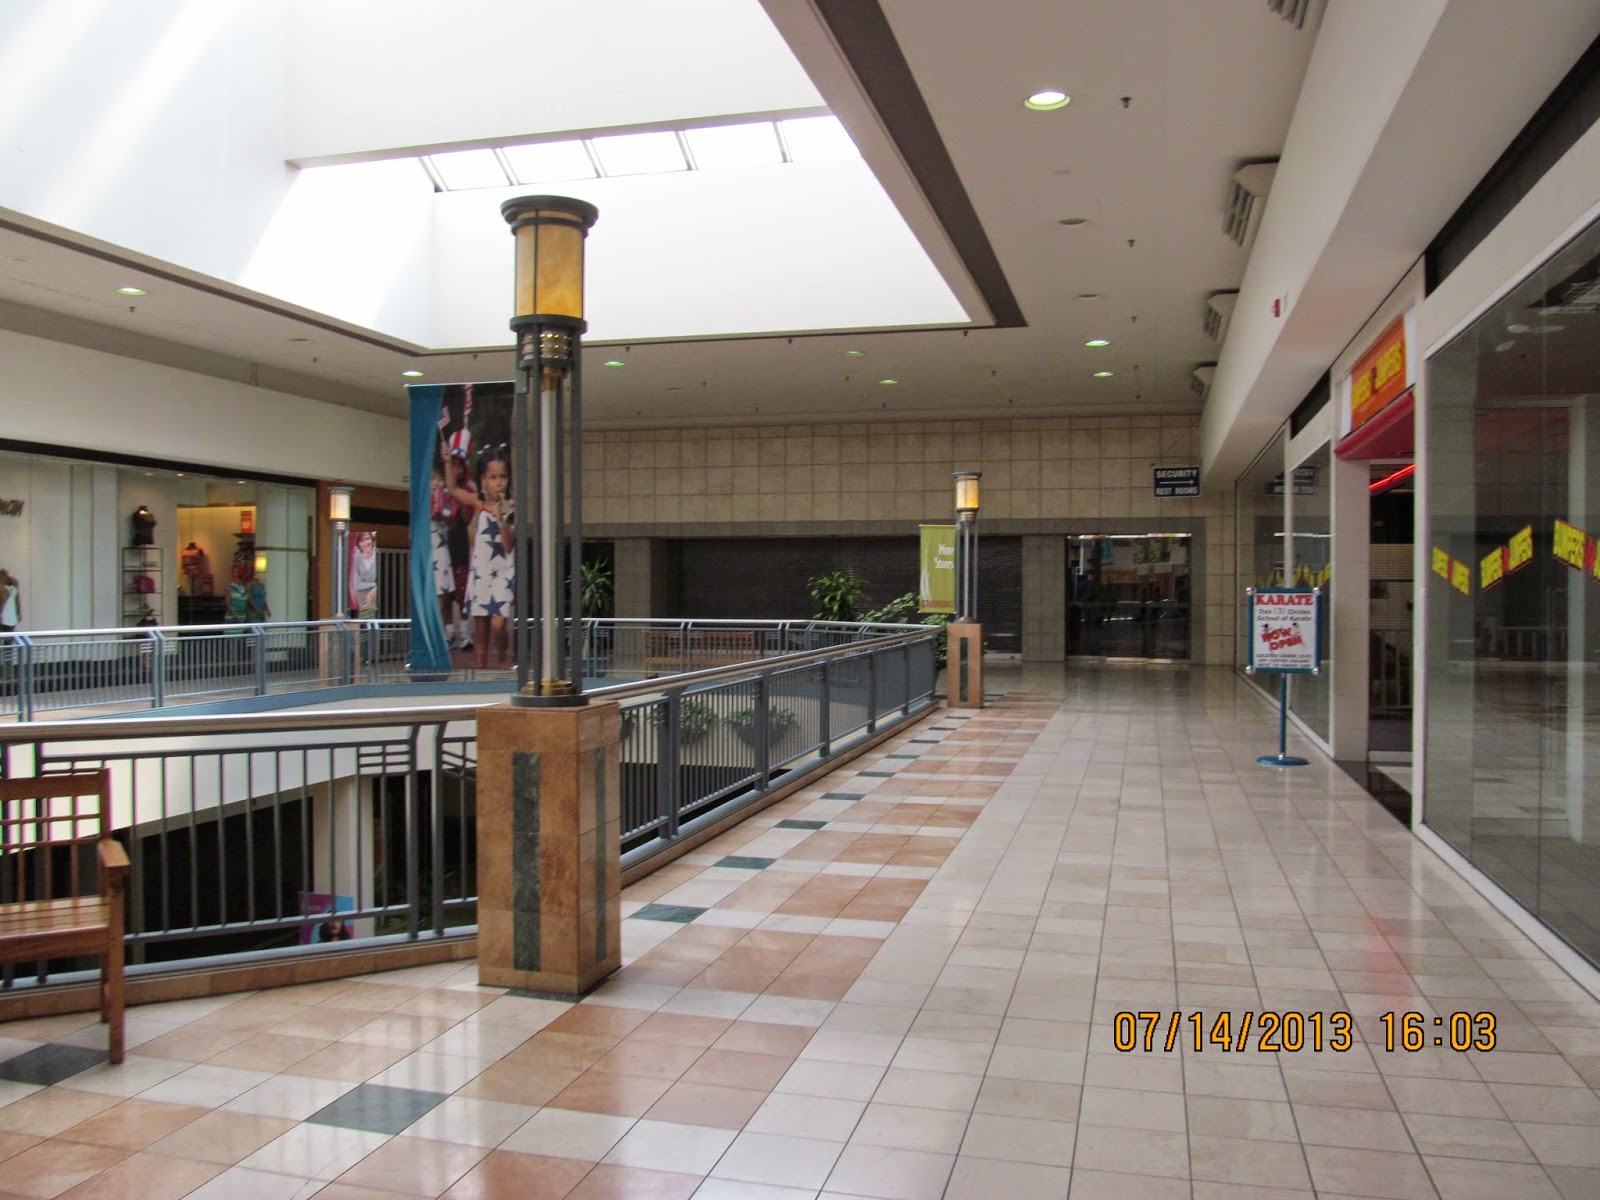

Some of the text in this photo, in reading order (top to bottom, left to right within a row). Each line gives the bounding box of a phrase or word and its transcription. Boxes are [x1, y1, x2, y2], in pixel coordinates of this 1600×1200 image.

[1155, 469, 1199, 479] SECURITY
[1155, 486, 1199, 496] REST ROOMS
[938, 543, 955, 556] More
[933, 556, 955, 570] Stores
[1256, 594, 1313, 605] KARATE
[1262, 628, 1292, 642] NOW
[1270, 635, 1303, 650] OPEN
